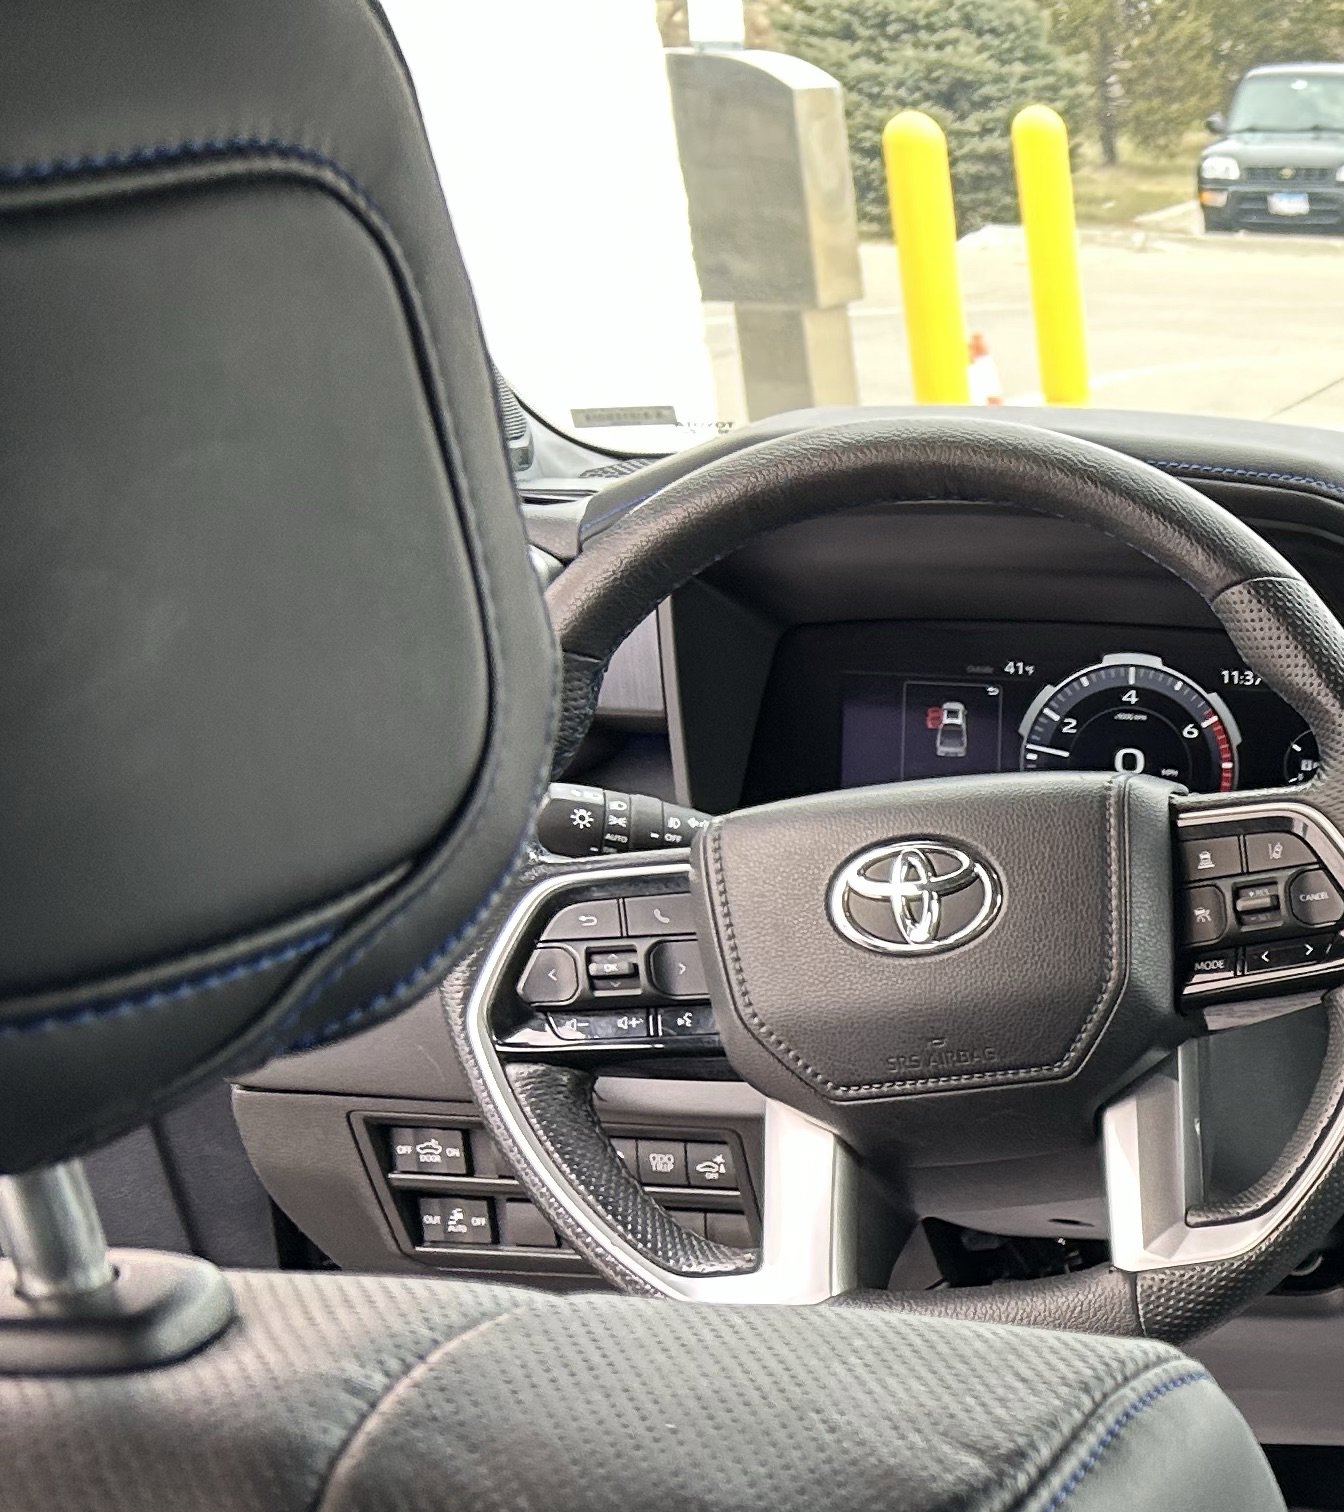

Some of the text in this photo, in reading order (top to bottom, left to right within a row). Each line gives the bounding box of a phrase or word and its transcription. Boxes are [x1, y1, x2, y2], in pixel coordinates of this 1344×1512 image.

[1121, 689, 1139, 705] 4
[1061, 717, 1078, 734] 2
[1182, 723, 1200, 739] 6
[1113, 747, 1146, 775] 0
[664, 832, 683, 843] OFF
[1299, 891, 1329, 902] CANCEL
[603, 963, 619, 973] OK
[1193, 959, 1225, 972] MODE
[928, 1046, 997, 1068] AIRBAG
